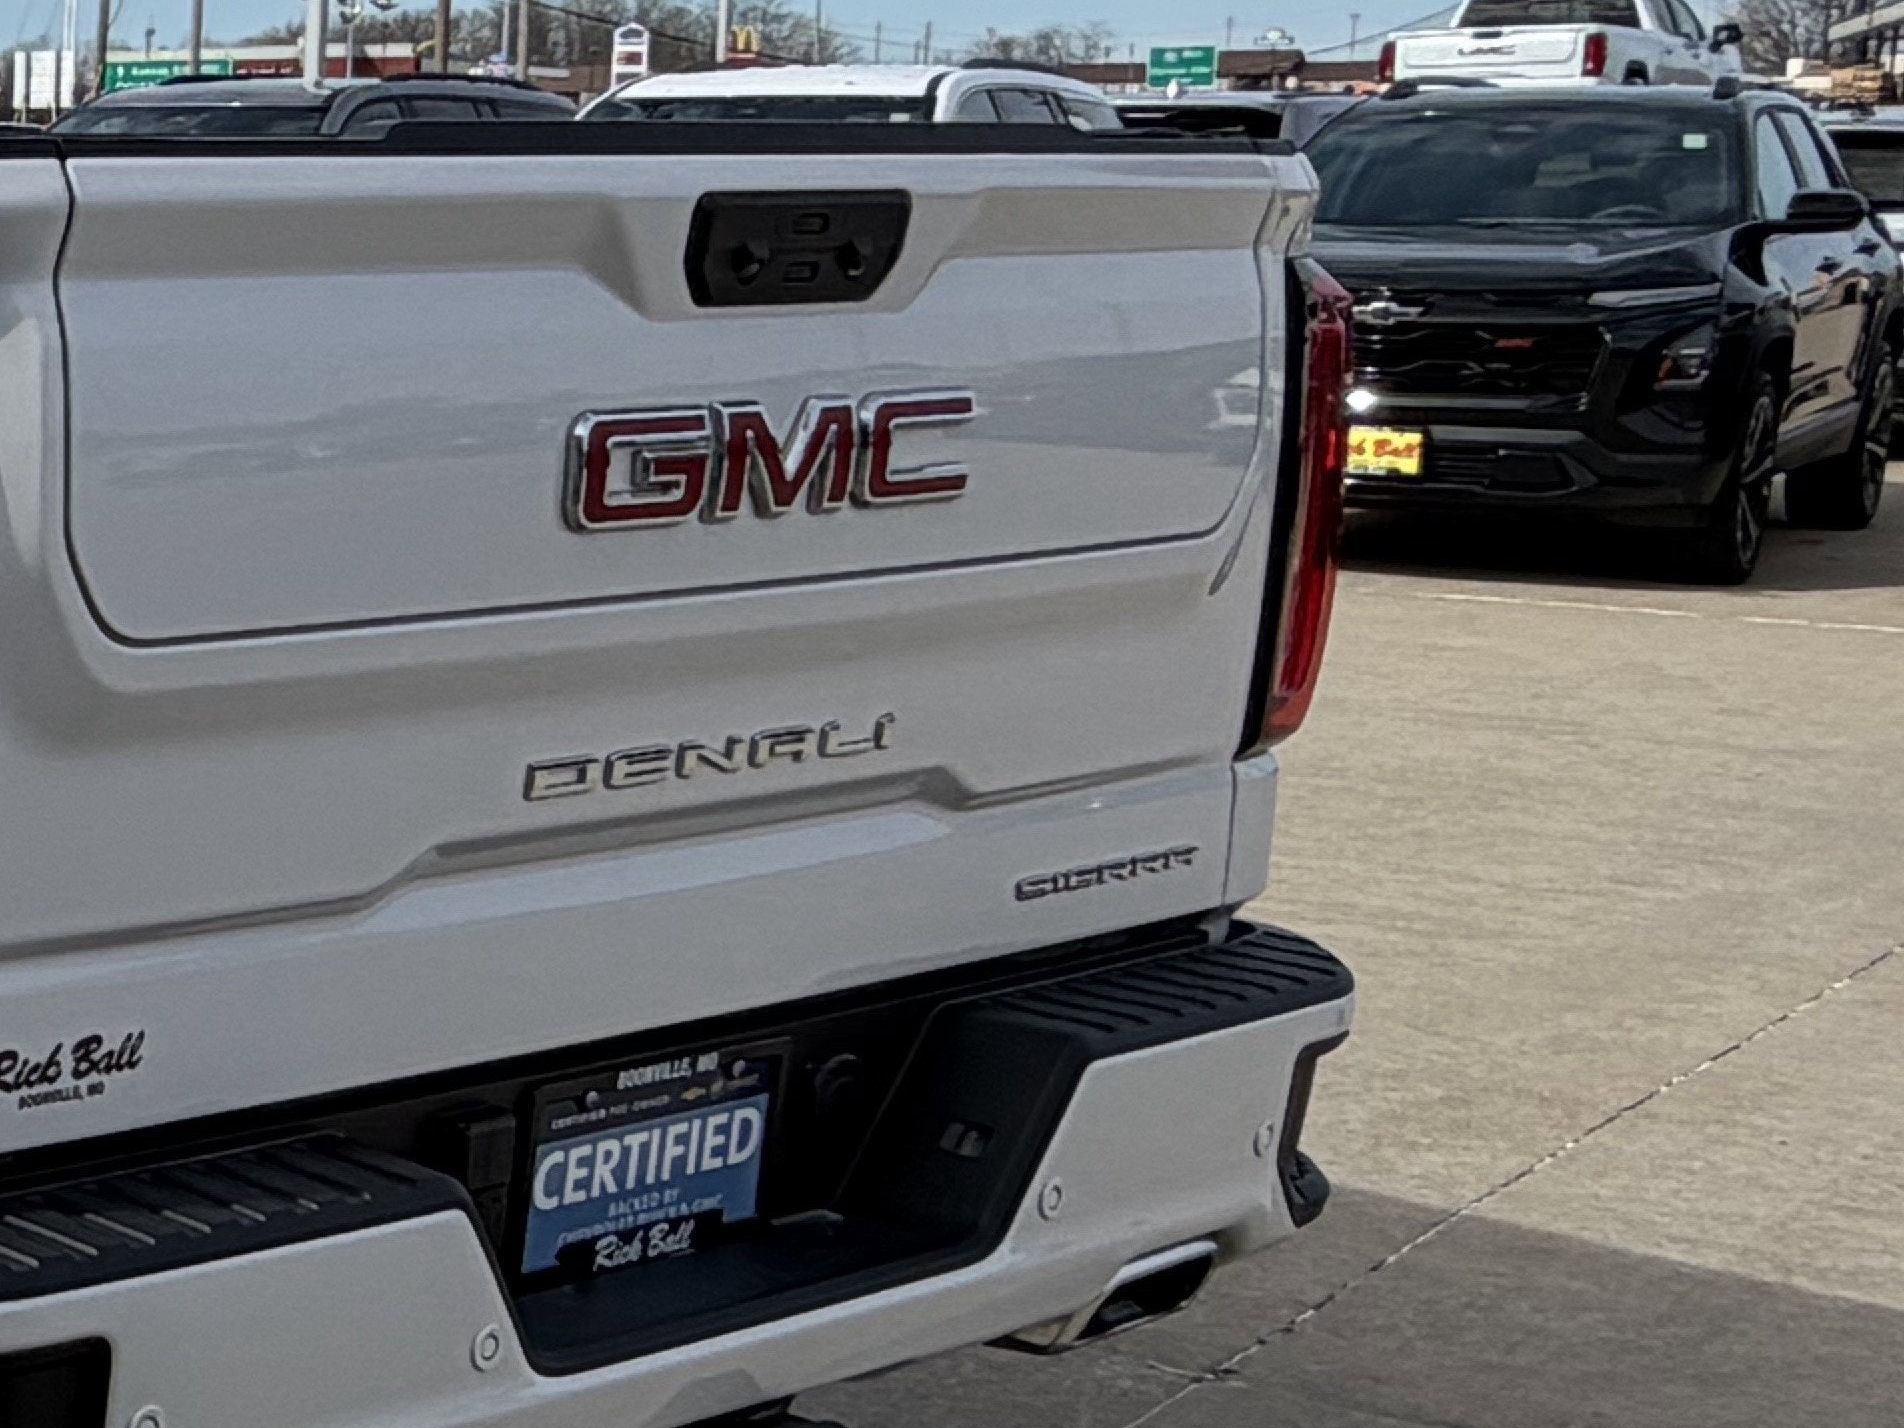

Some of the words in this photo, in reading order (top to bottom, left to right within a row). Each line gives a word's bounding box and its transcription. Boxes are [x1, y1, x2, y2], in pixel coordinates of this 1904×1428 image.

[560, 386, 975, 533] GMC
[522, 711, 896, 803] DENALI
[1014, 844, 1201, 902] SIERRA
[71, 1028, 146, 1081] Ball
[532, 1106, 763, 1211] CERTIFIED
[593, 1228, 644, 1272] Rick
[647, 1218, 696, 1257] Ball
